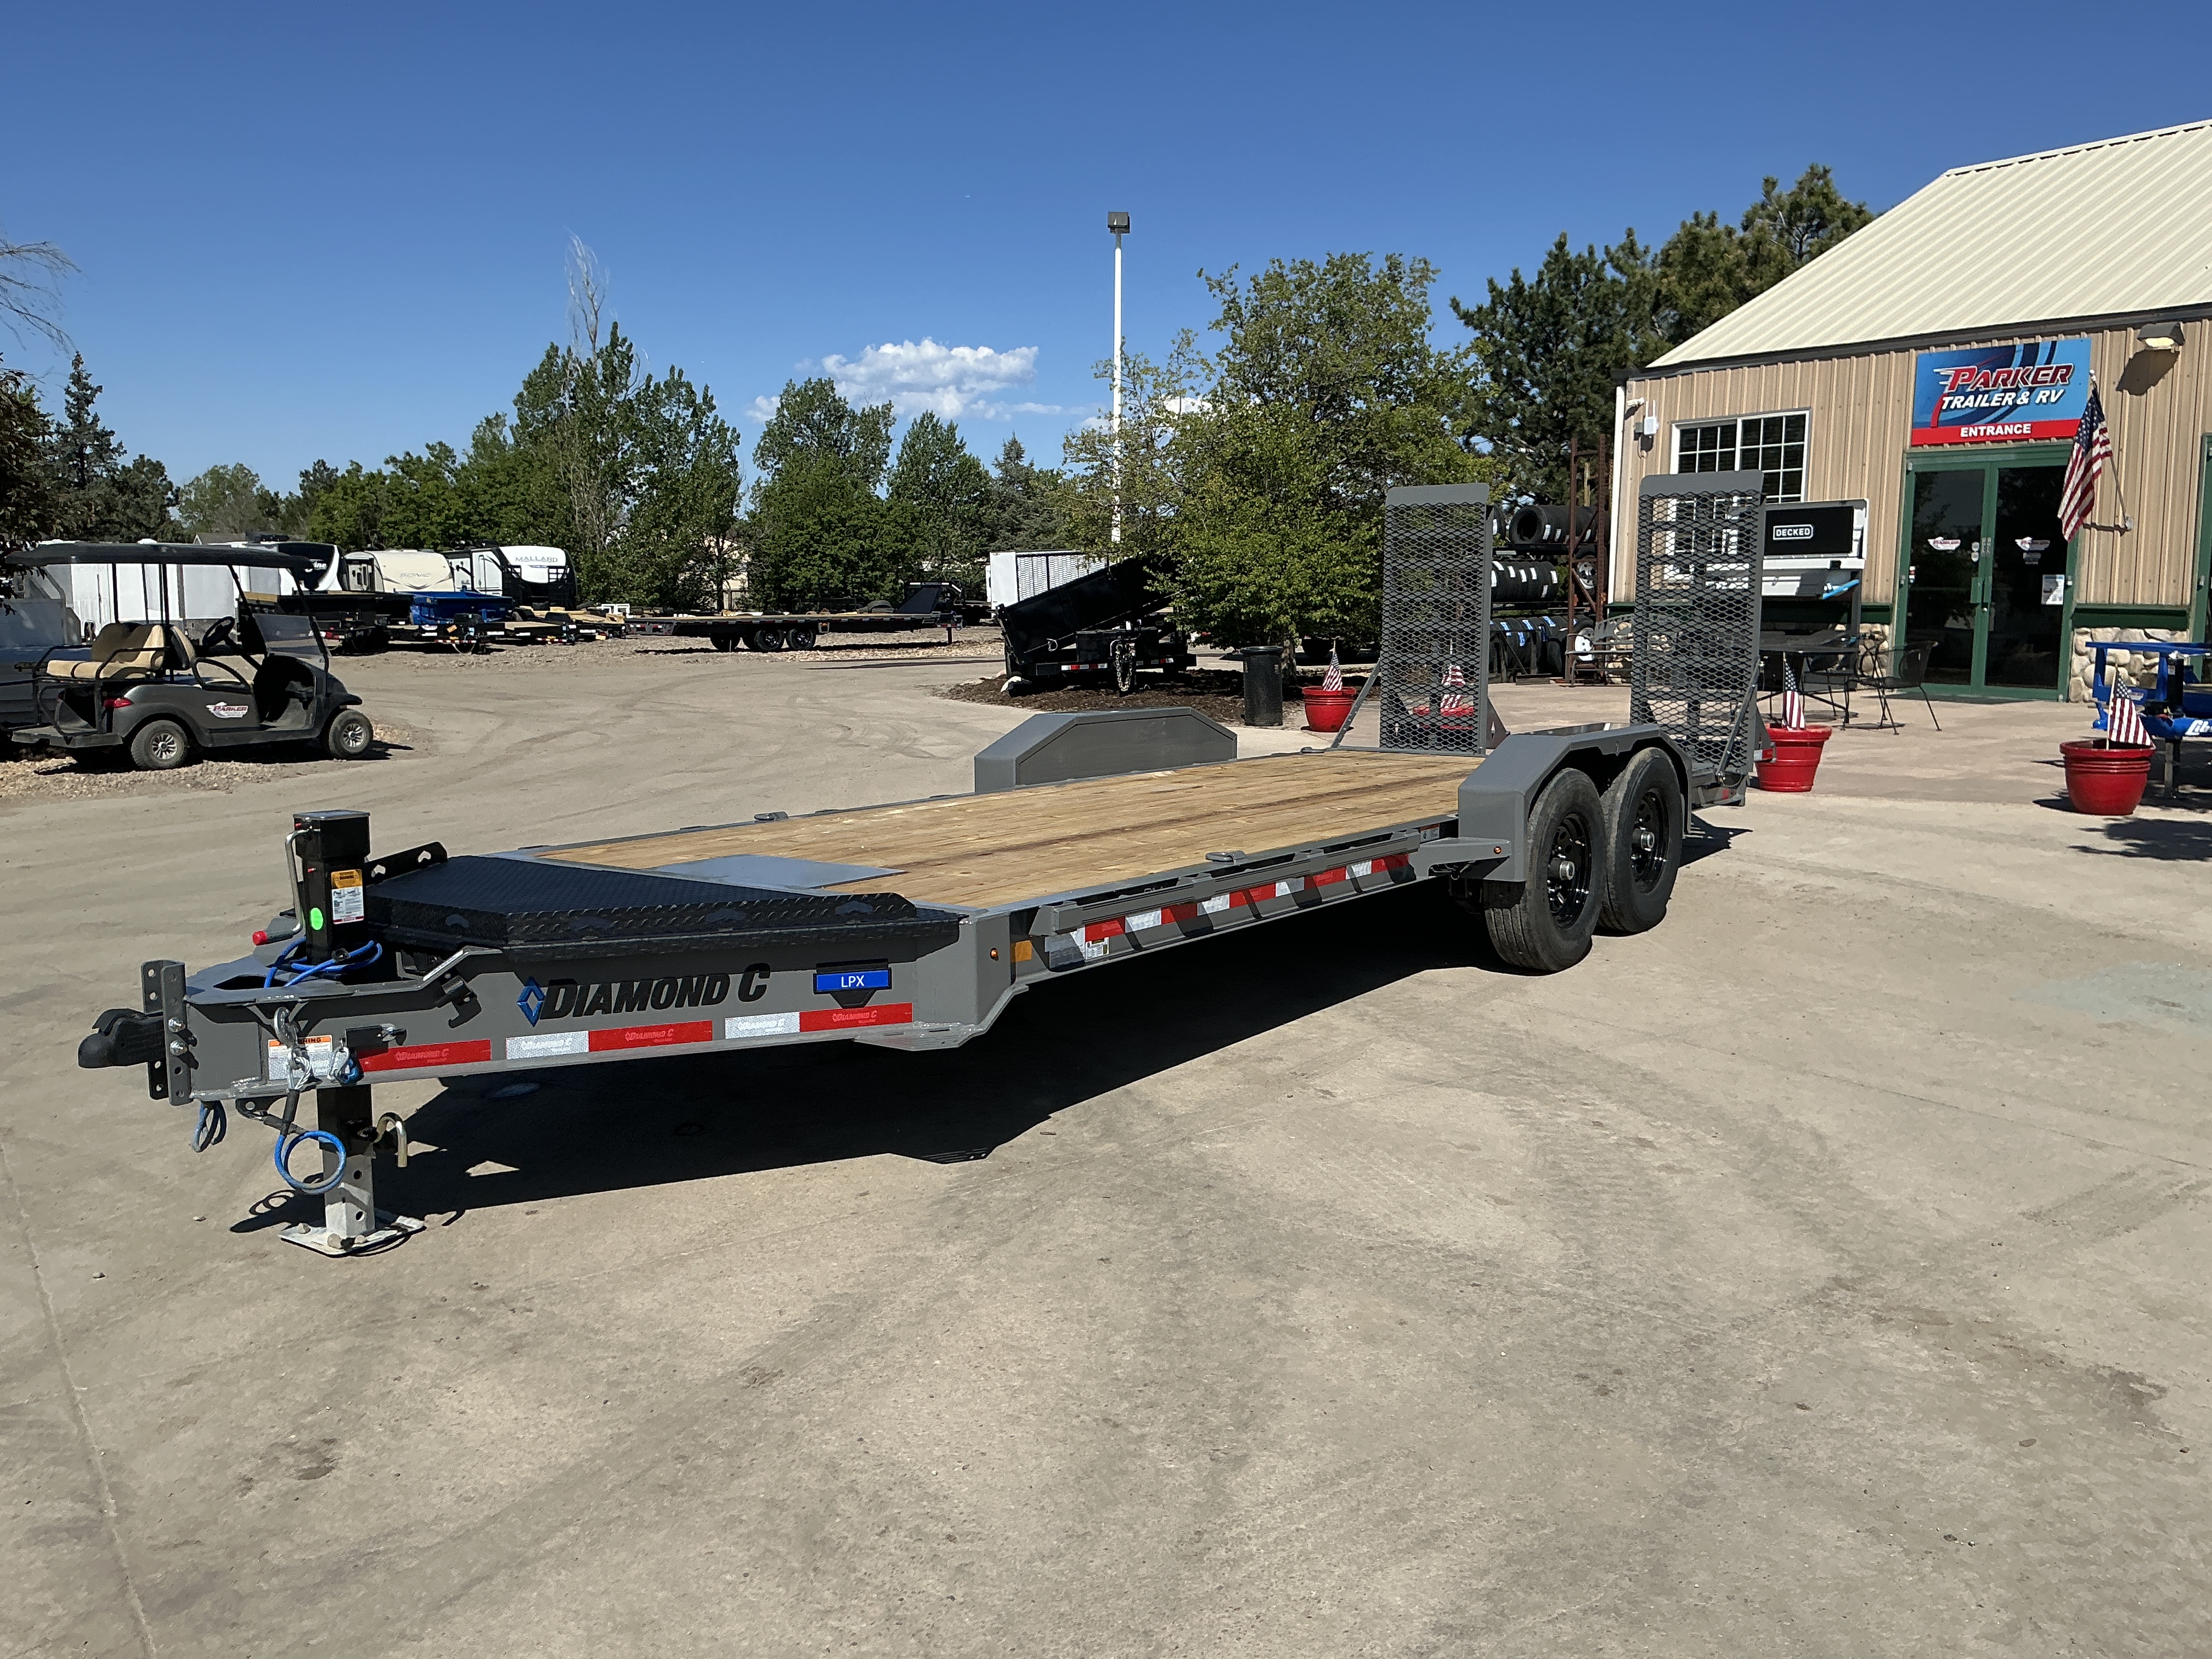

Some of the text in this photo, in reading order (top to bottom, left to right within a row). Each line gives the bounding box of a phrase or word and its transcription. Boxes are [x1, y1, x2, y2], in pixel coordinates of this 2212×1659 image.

[1940, 363, 2074, 392] PARKER
[1942, 388, 2064, 410] TRAILER & RV
[1960, 423, 2032, 438] ENTRANCE
[1776, 528, 1810, 537] DECKED
[2185, 720, 2212, 735] Lib
[841, 974, 865, 988] LPX
[540, 962, 771, 1020] DIAMOND C
